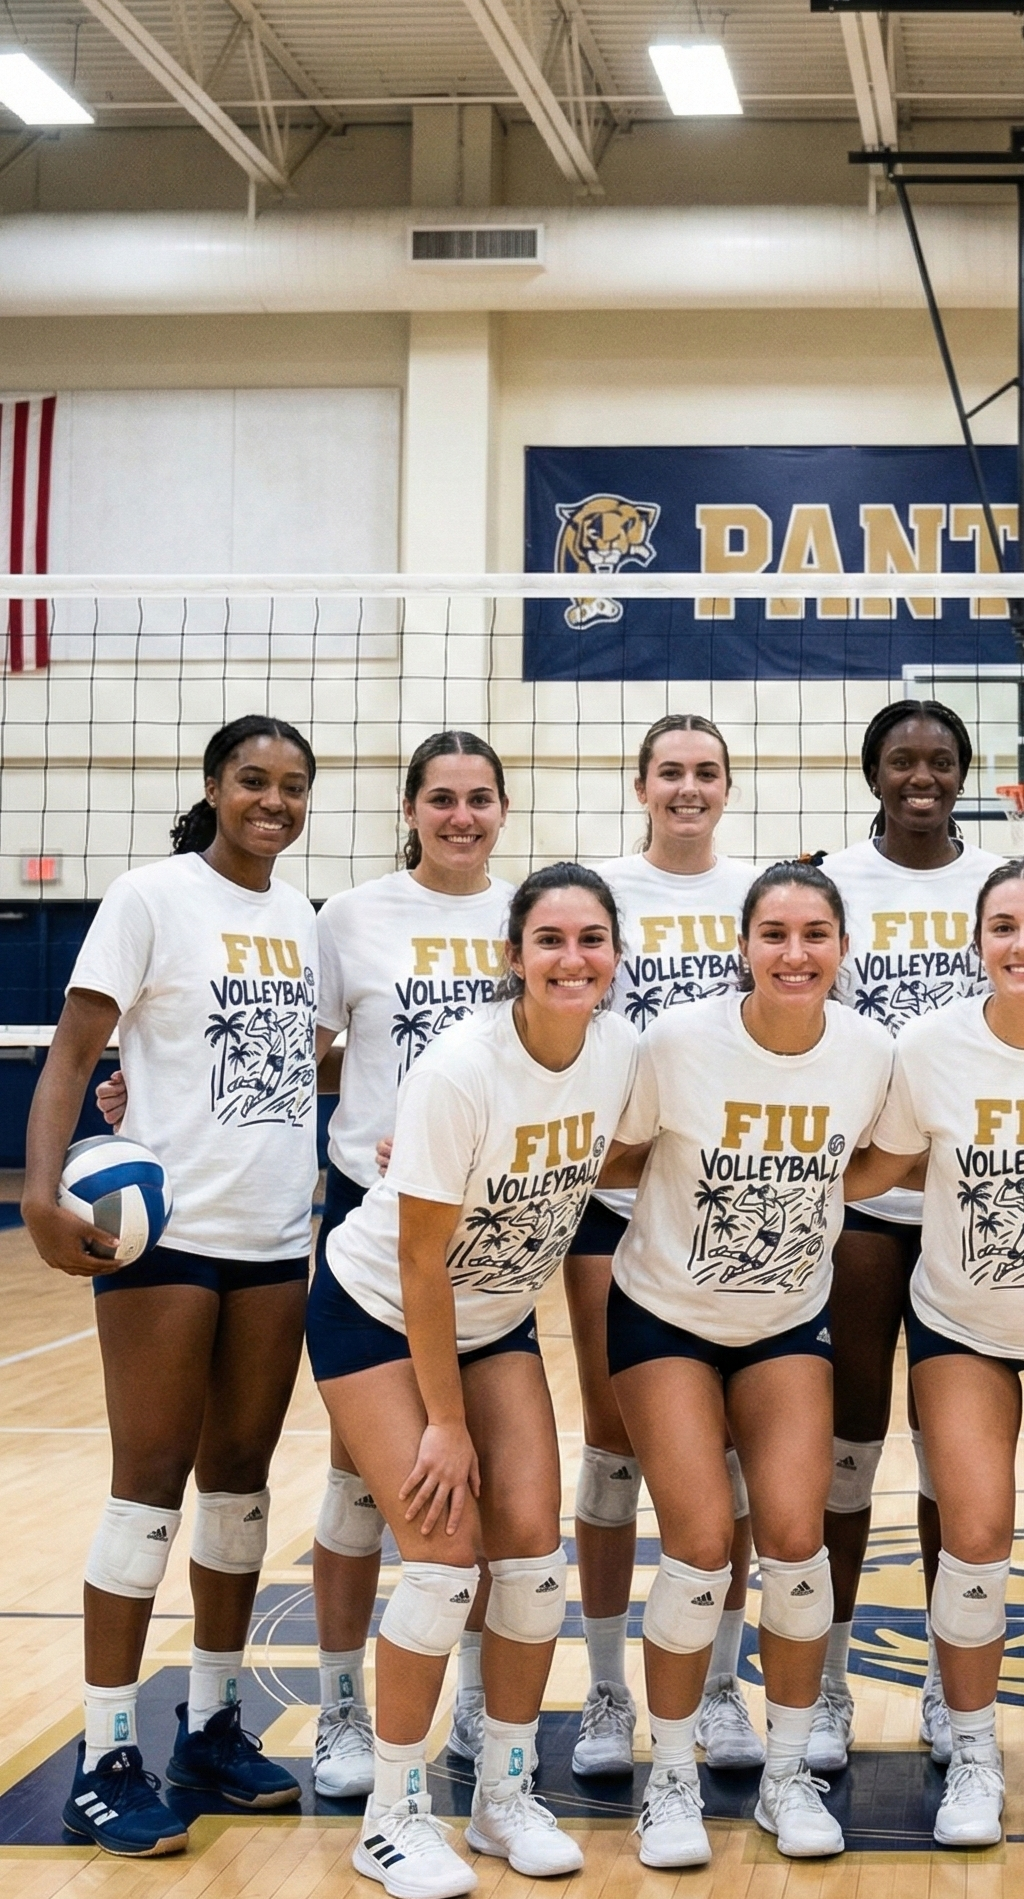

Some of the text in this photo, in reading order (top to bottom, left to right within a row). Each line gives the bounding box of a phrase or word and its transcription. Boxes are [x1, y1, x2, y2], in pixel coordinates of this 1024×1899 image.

[640, 915, 737, 954] FIU
[872, 911, 969, 950] FIU
[221, 933, 300, 979] FIU
[411, 937, 504, 977] FIU
[624, 954, 740, 988] VOLLEYBA
[854, 952, 988, 985] VOLLEYBALL
[395, 977, 496, 1011] VOLLEYB
[510, 1111, 595, 1173] FIU
[721, 1101, 830, 1153] FIU
[487, 1158, 599, 1204] VOLLEYBALL
[700, 1147, 840, 1184] VOLLEYBALL
